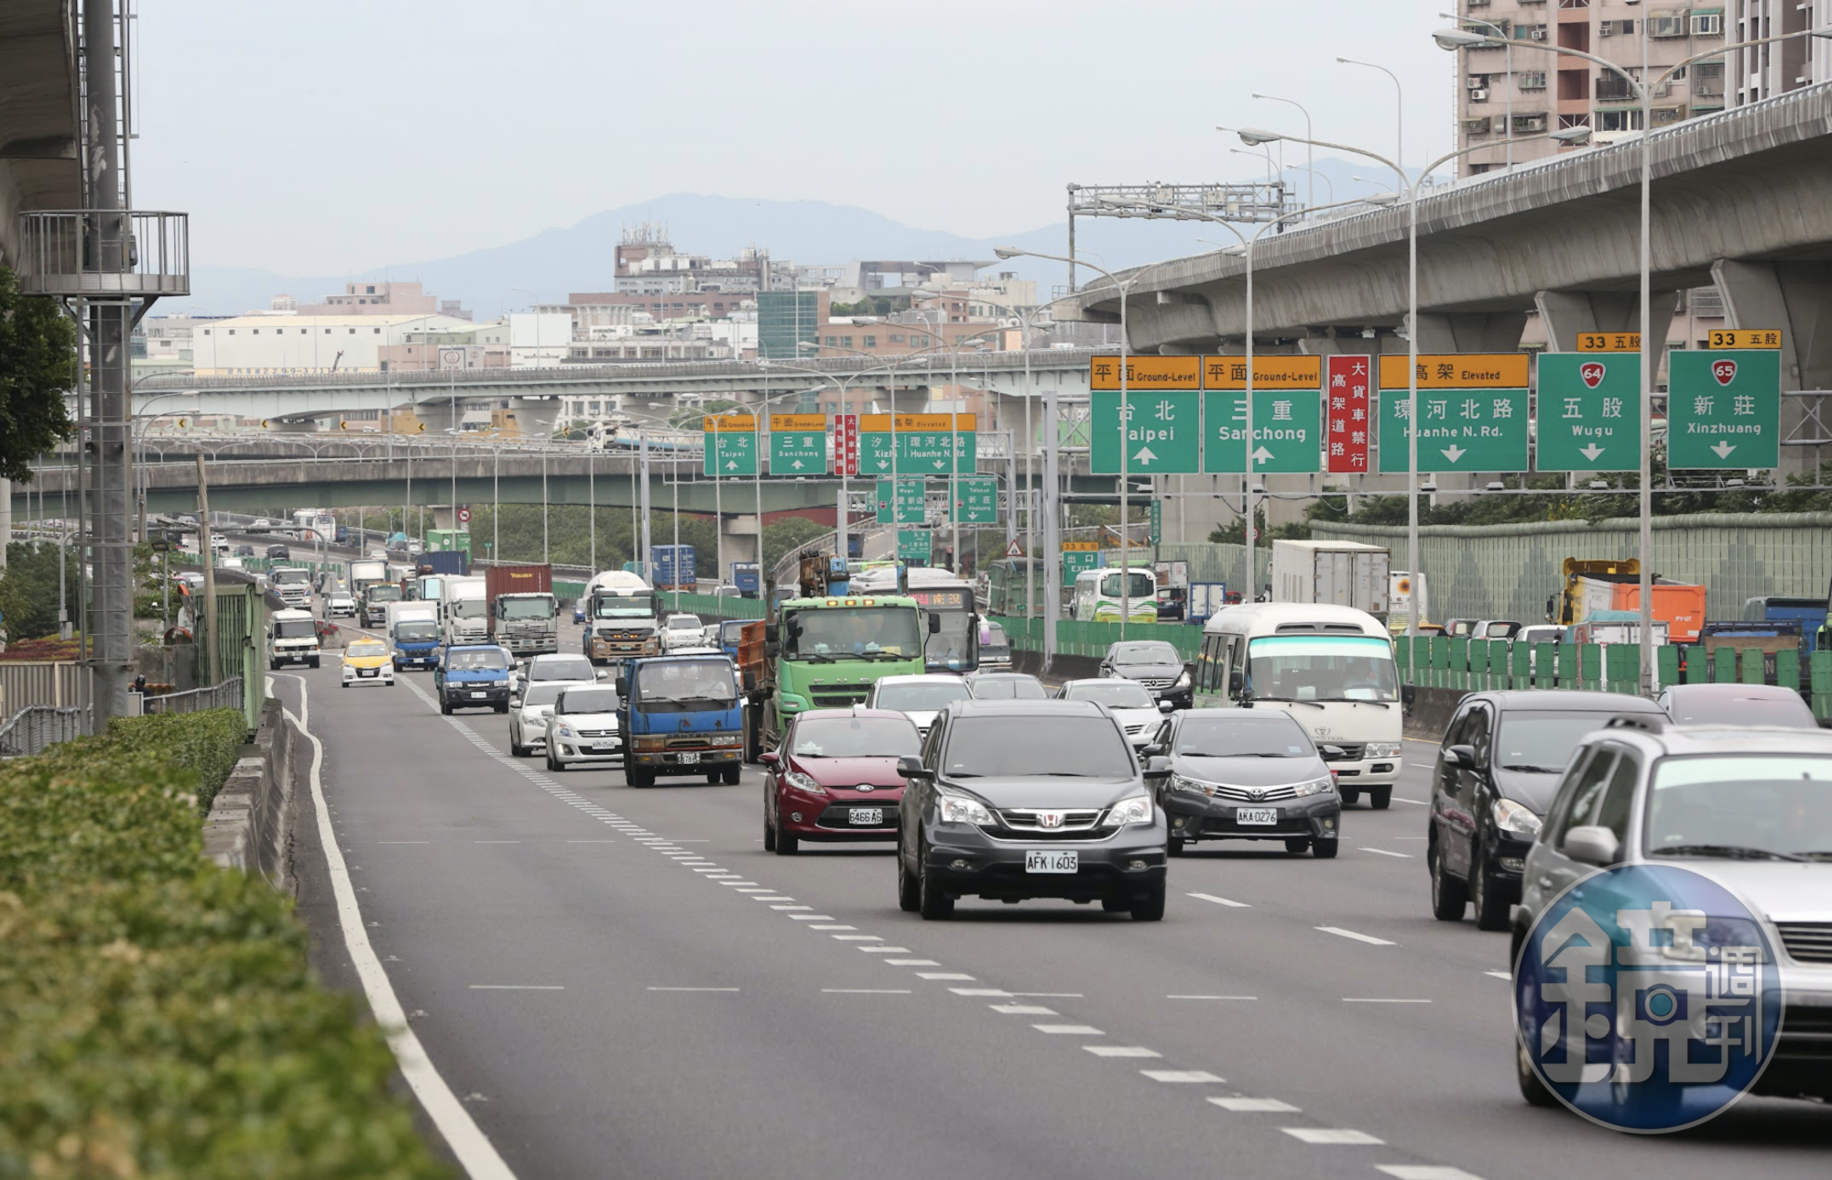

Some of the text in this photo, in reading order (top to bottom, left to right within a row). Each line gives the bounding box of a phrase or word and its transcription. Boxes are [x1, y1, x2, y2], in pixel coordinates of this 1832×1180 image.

[1585, 336, 1606, 348] 33
[1714, 333, 1777, 346] 33 五股
[1095, 364, 1196, 382] 平面 Ground-Level
[1208, 364, 1318, 382] 平面 Ground-Level
[1416, 363, 1500, 380] 高架 Elevated
[1584, 368, 1601, 379] 64
[1716, 366, 1734, 376] 65
[1116, 400, 1174, 420] 台北
[1232, 400, 1292, 420] 三重
[1394, 398, 1513, 420] 環河北路
[1562, 398, 1622, 418] 五股
[1694, 395, 1754, 416] 新莊
[1331, 374, 1346, 456] 高架道路
[1351, 362, 1366, 466] 大貨車禁行
[1117, 426, 1174, 443] aipei
[1463, 426, 1477, 437] N.
[1481, 426, 1503, 437] Rd.
[1572, 426, 1613, 438] Wugu
[1687, 422, 1762, 436] Xinzhuang
[718, 437, 748, 448] 台北
[783, 436, 814, 448] 三重
[1068, 555, 1093, 563] 出口
[1027, 856, 1076, 869] AFK-1603
